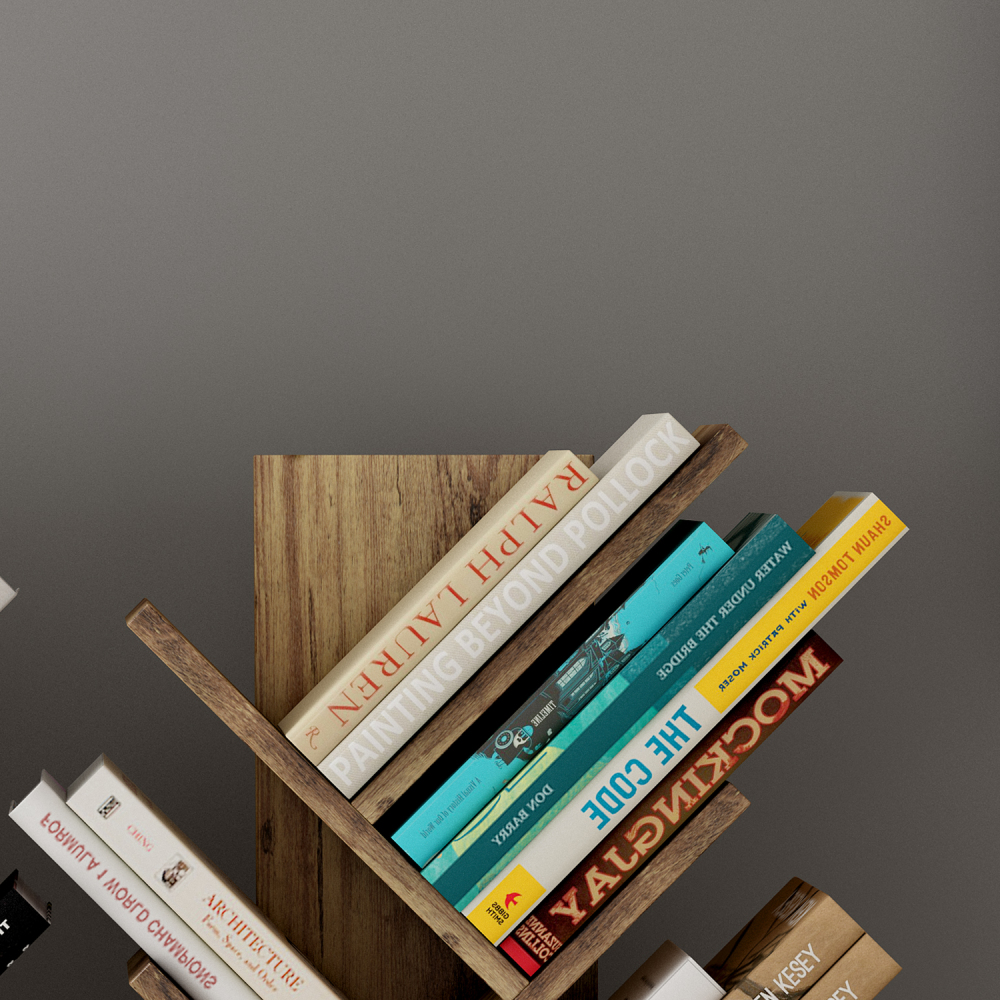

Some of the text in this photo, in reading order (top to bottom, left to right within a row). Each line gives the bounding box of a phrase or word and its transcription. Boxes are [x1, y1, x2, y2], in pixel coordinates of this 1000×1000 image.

[327, 419, 682, 778] PAINTING BEYOND POLLOCK
[328, 463, 589, 727] RALPH LAUREN
[207, 894, 304, 992] ARCHITECTURE
[772, 942, 821, 995] KESEY
